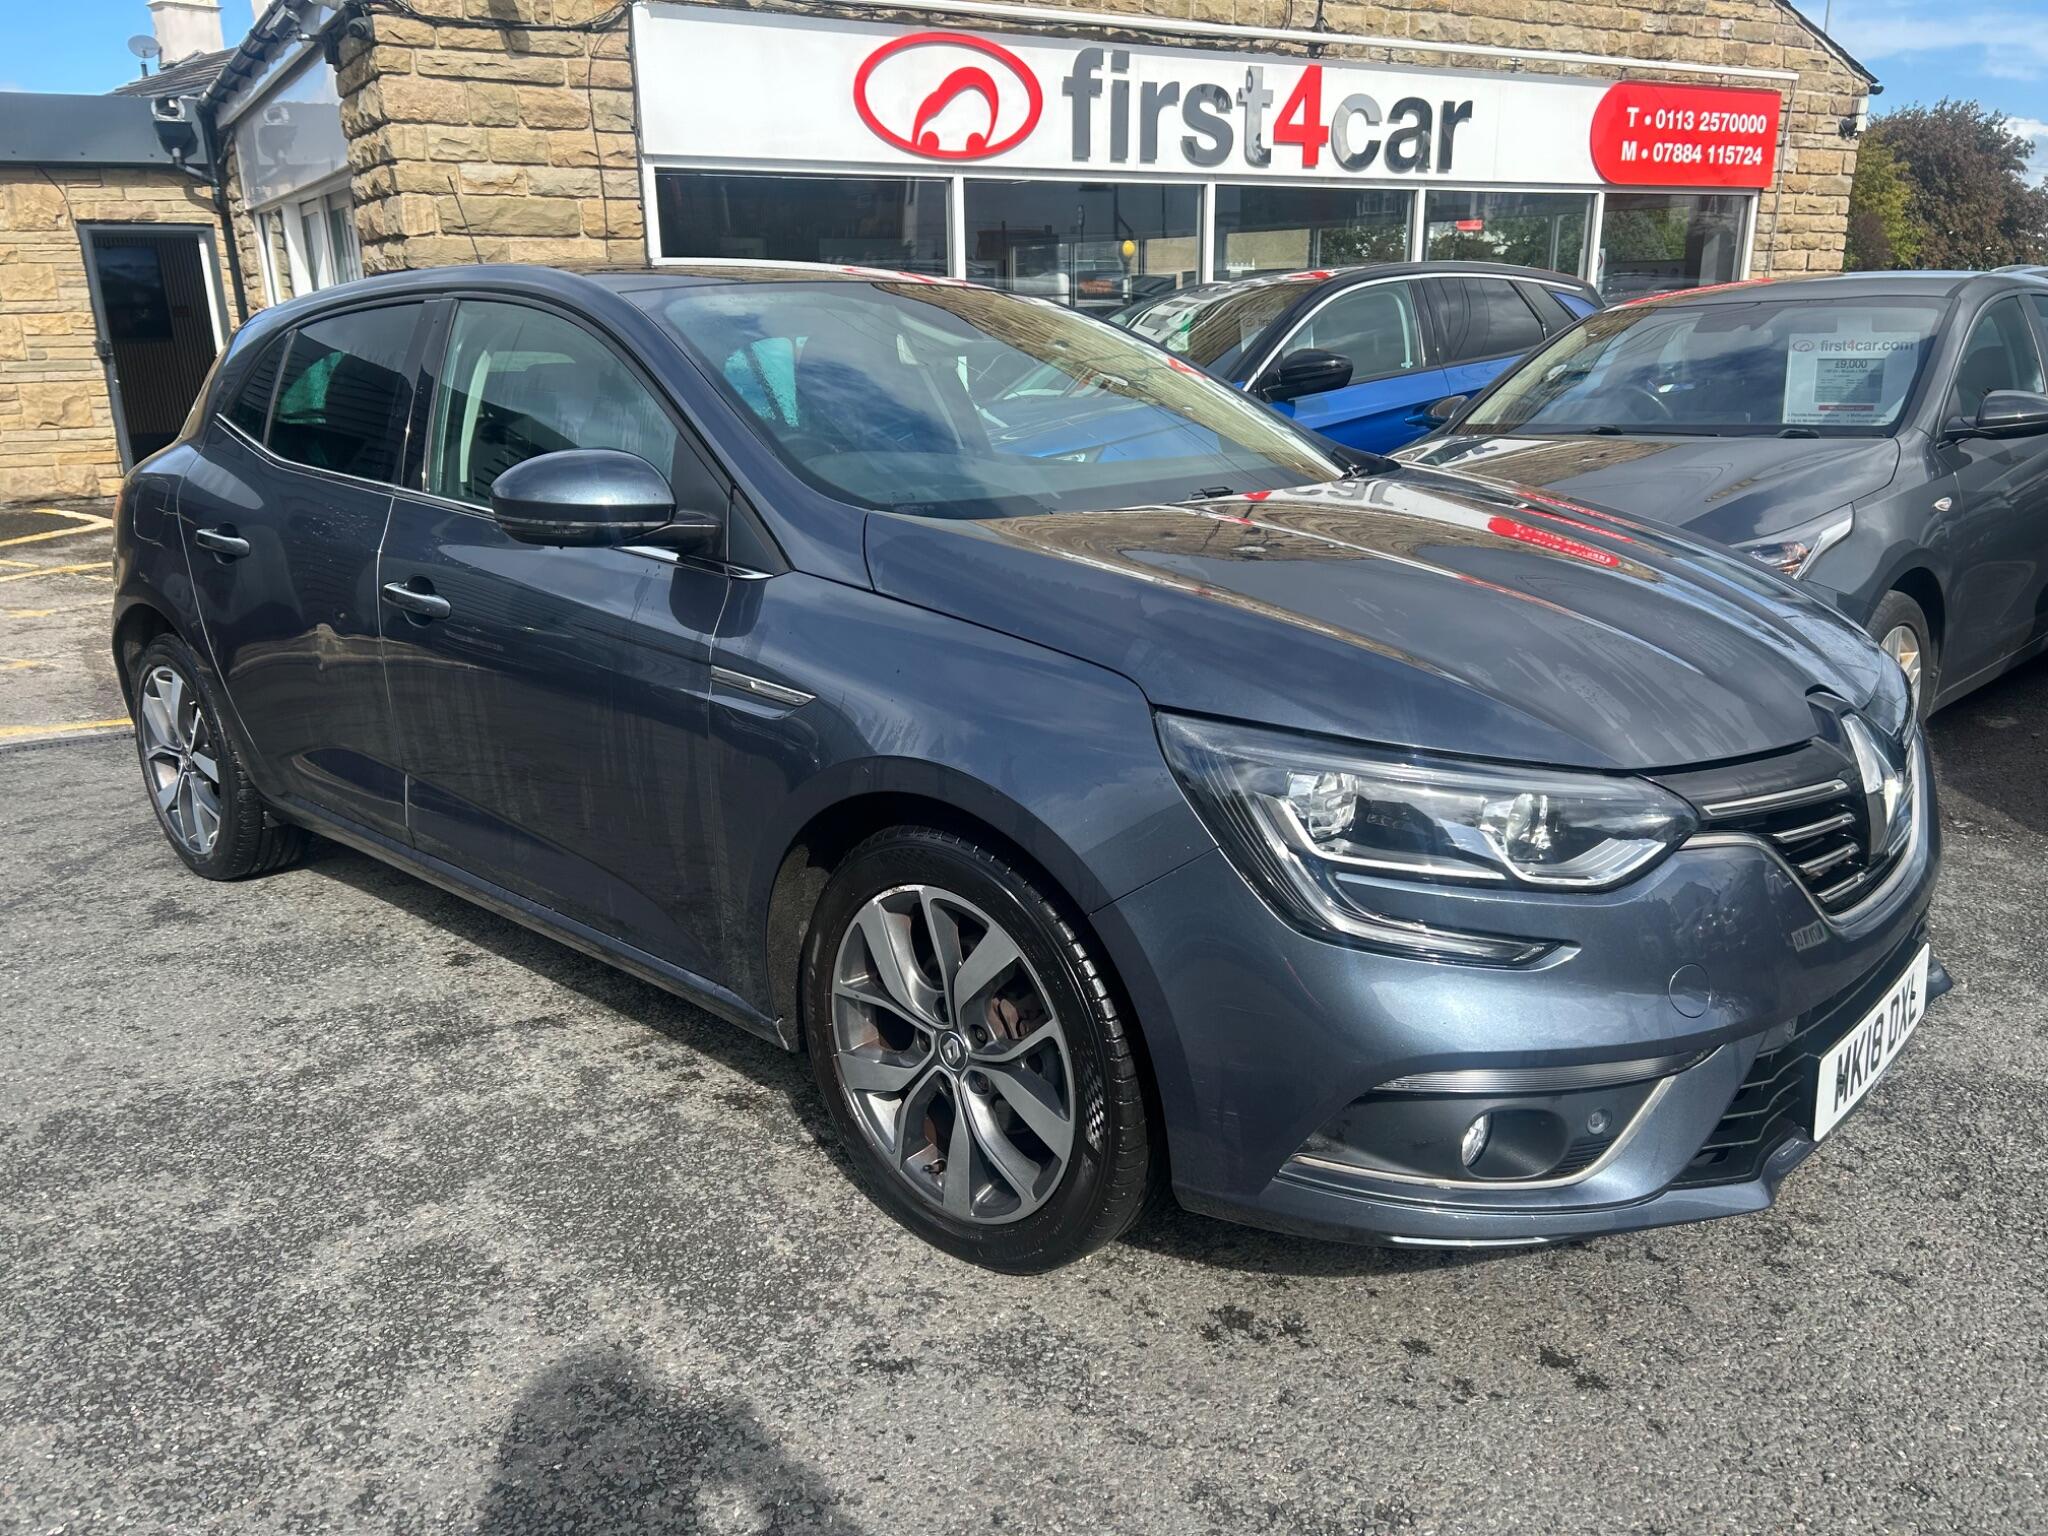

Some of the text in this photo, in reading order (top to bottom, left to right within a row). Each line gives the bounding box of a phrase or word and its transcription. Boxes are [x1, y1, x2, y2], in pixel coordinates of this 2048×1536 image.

[1062, 47, 1473, 172] first4car
[1626, 107, 1767, 134] T 0113 2570000
[1621, 140, 1762, 166] M 07884 115724
[1820, 339, 1914, 353] first4car.com
[1833, 1012, 1884, 1114] MK18
